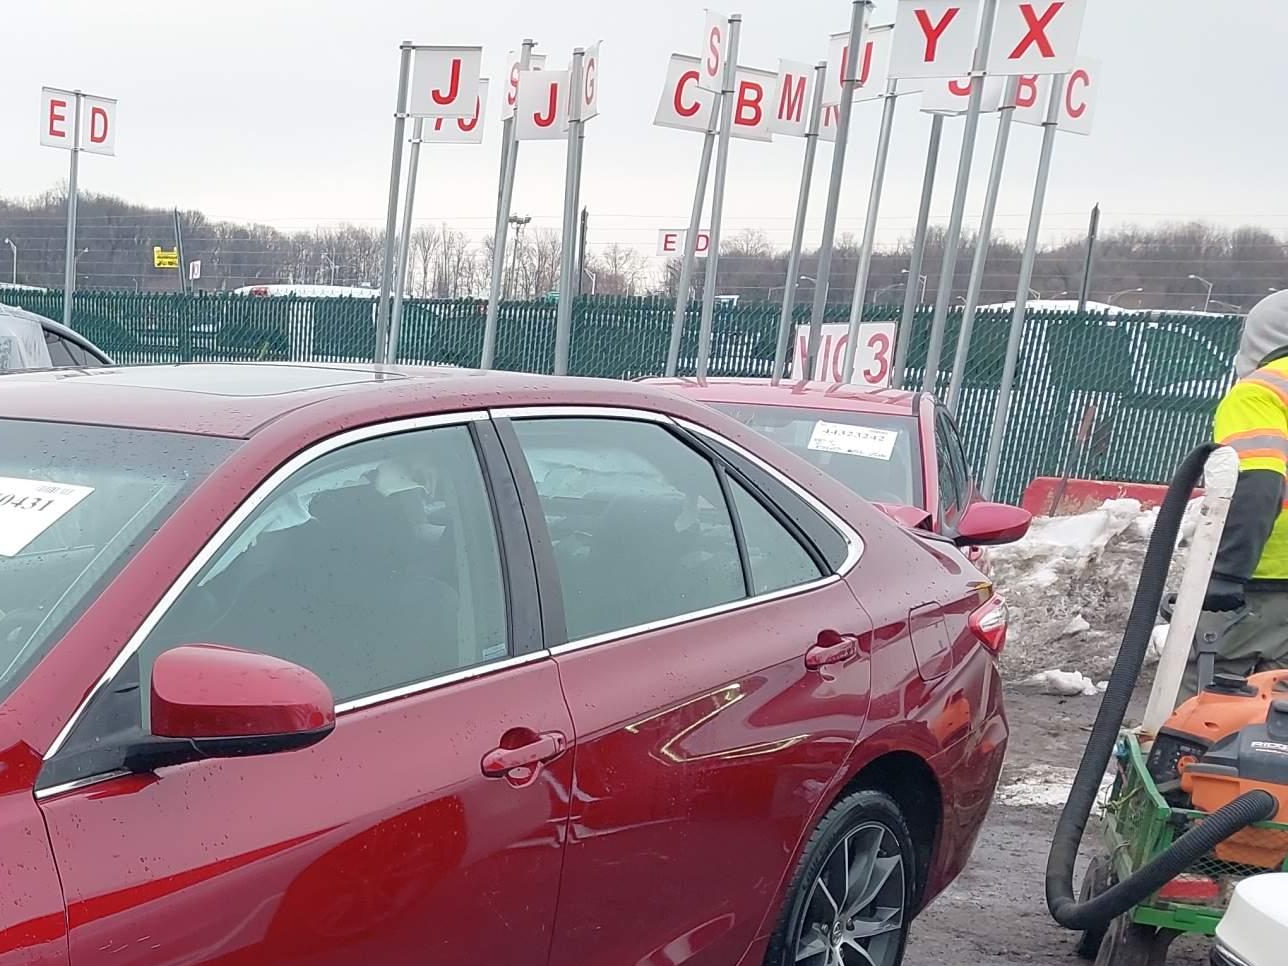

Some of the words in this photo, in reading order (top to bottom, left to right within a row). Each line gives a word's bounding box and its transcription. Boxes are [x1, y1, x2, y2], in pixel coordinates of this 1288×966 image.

[707, 27, 721, 76] S
[913, 8, 960, 62] Y
[1008, 2, 1063, 59] X
[431, 59, 461, 105] J
[585, 58, 595, 105] G
[839, 41, 874, 89] U
[533, 83, 558, 127] J
[673, 71, 701, 117] C
[734, 80, 764, 126] B
[777, 74, 806, 122] M
[1066, 69, 1089, 118] C
[49, 99, 66, 137] E
[90, 107, 109, 143] D
[663, 234, 677, 251] E
[695, 234, 709, 251] D
[863, 333, 890, 384] 3
